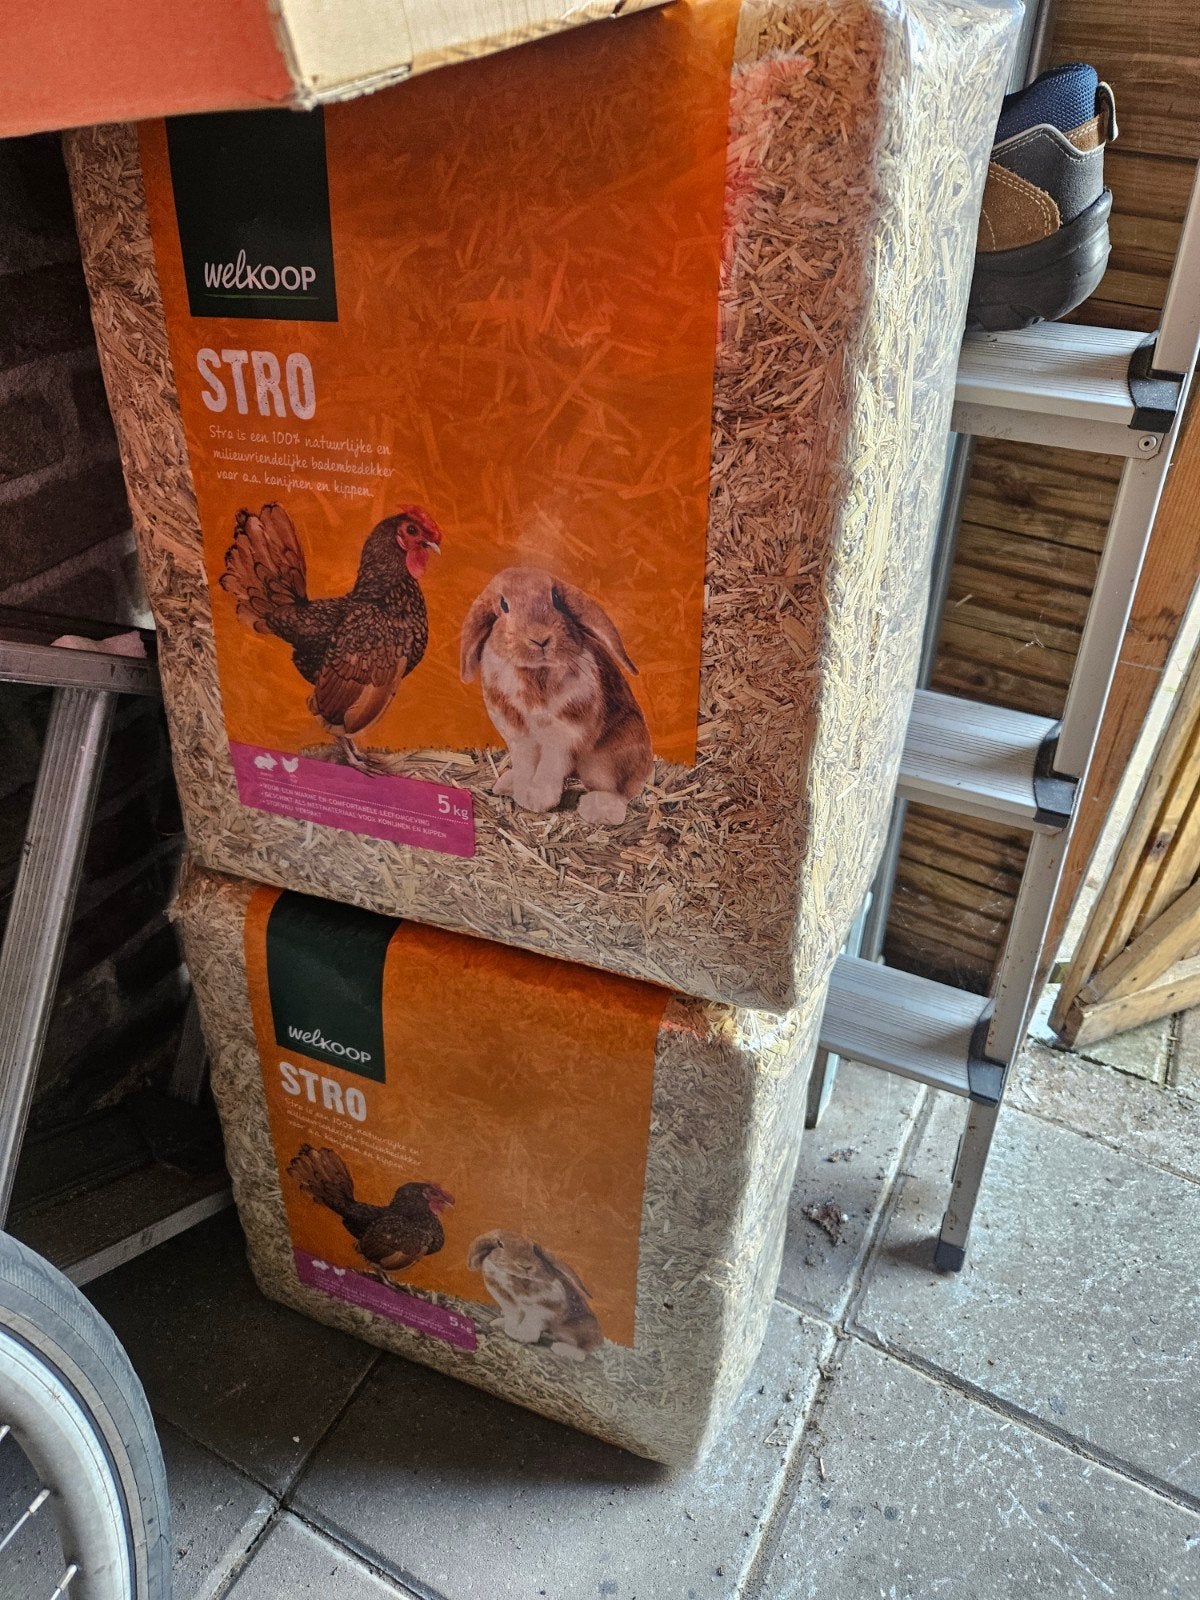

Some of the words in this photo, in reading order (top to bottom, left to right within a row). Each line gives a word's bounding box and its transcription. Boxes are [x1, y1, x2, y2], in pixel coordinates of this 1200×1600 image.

[196, 348, 317, 420] STRO
[209, 424, 234, 440] Stro
[237, 429, 246, 441] is
[250, 432, 269, 443] een
[272, 430, 300, 445] 100%
[305, 434, 373, 458] natuurlijke
[376, 444, 391, 455] en
[213, 447, 308, 472] milieuvriendelijke
[311, 456, 397, 478] bodembedekker
[217, 470, 238, 480] voor
[264, 470, 313, 493] konijnen
[316, 482, 331, 492] en
[329, 799, 378, 815] COMFORTABELE
[379, 809, 431, 826] LEEFOMGEVING
[437, 793, 451, 814] 5
[453, 805, 469, 820] kg
[412, 825, 422, 833] EN
[423, 828, 447, 839] KIPPEN
[279, 1061, 367, 1122] STRO
[449, 1315, 459, 1327] 5
